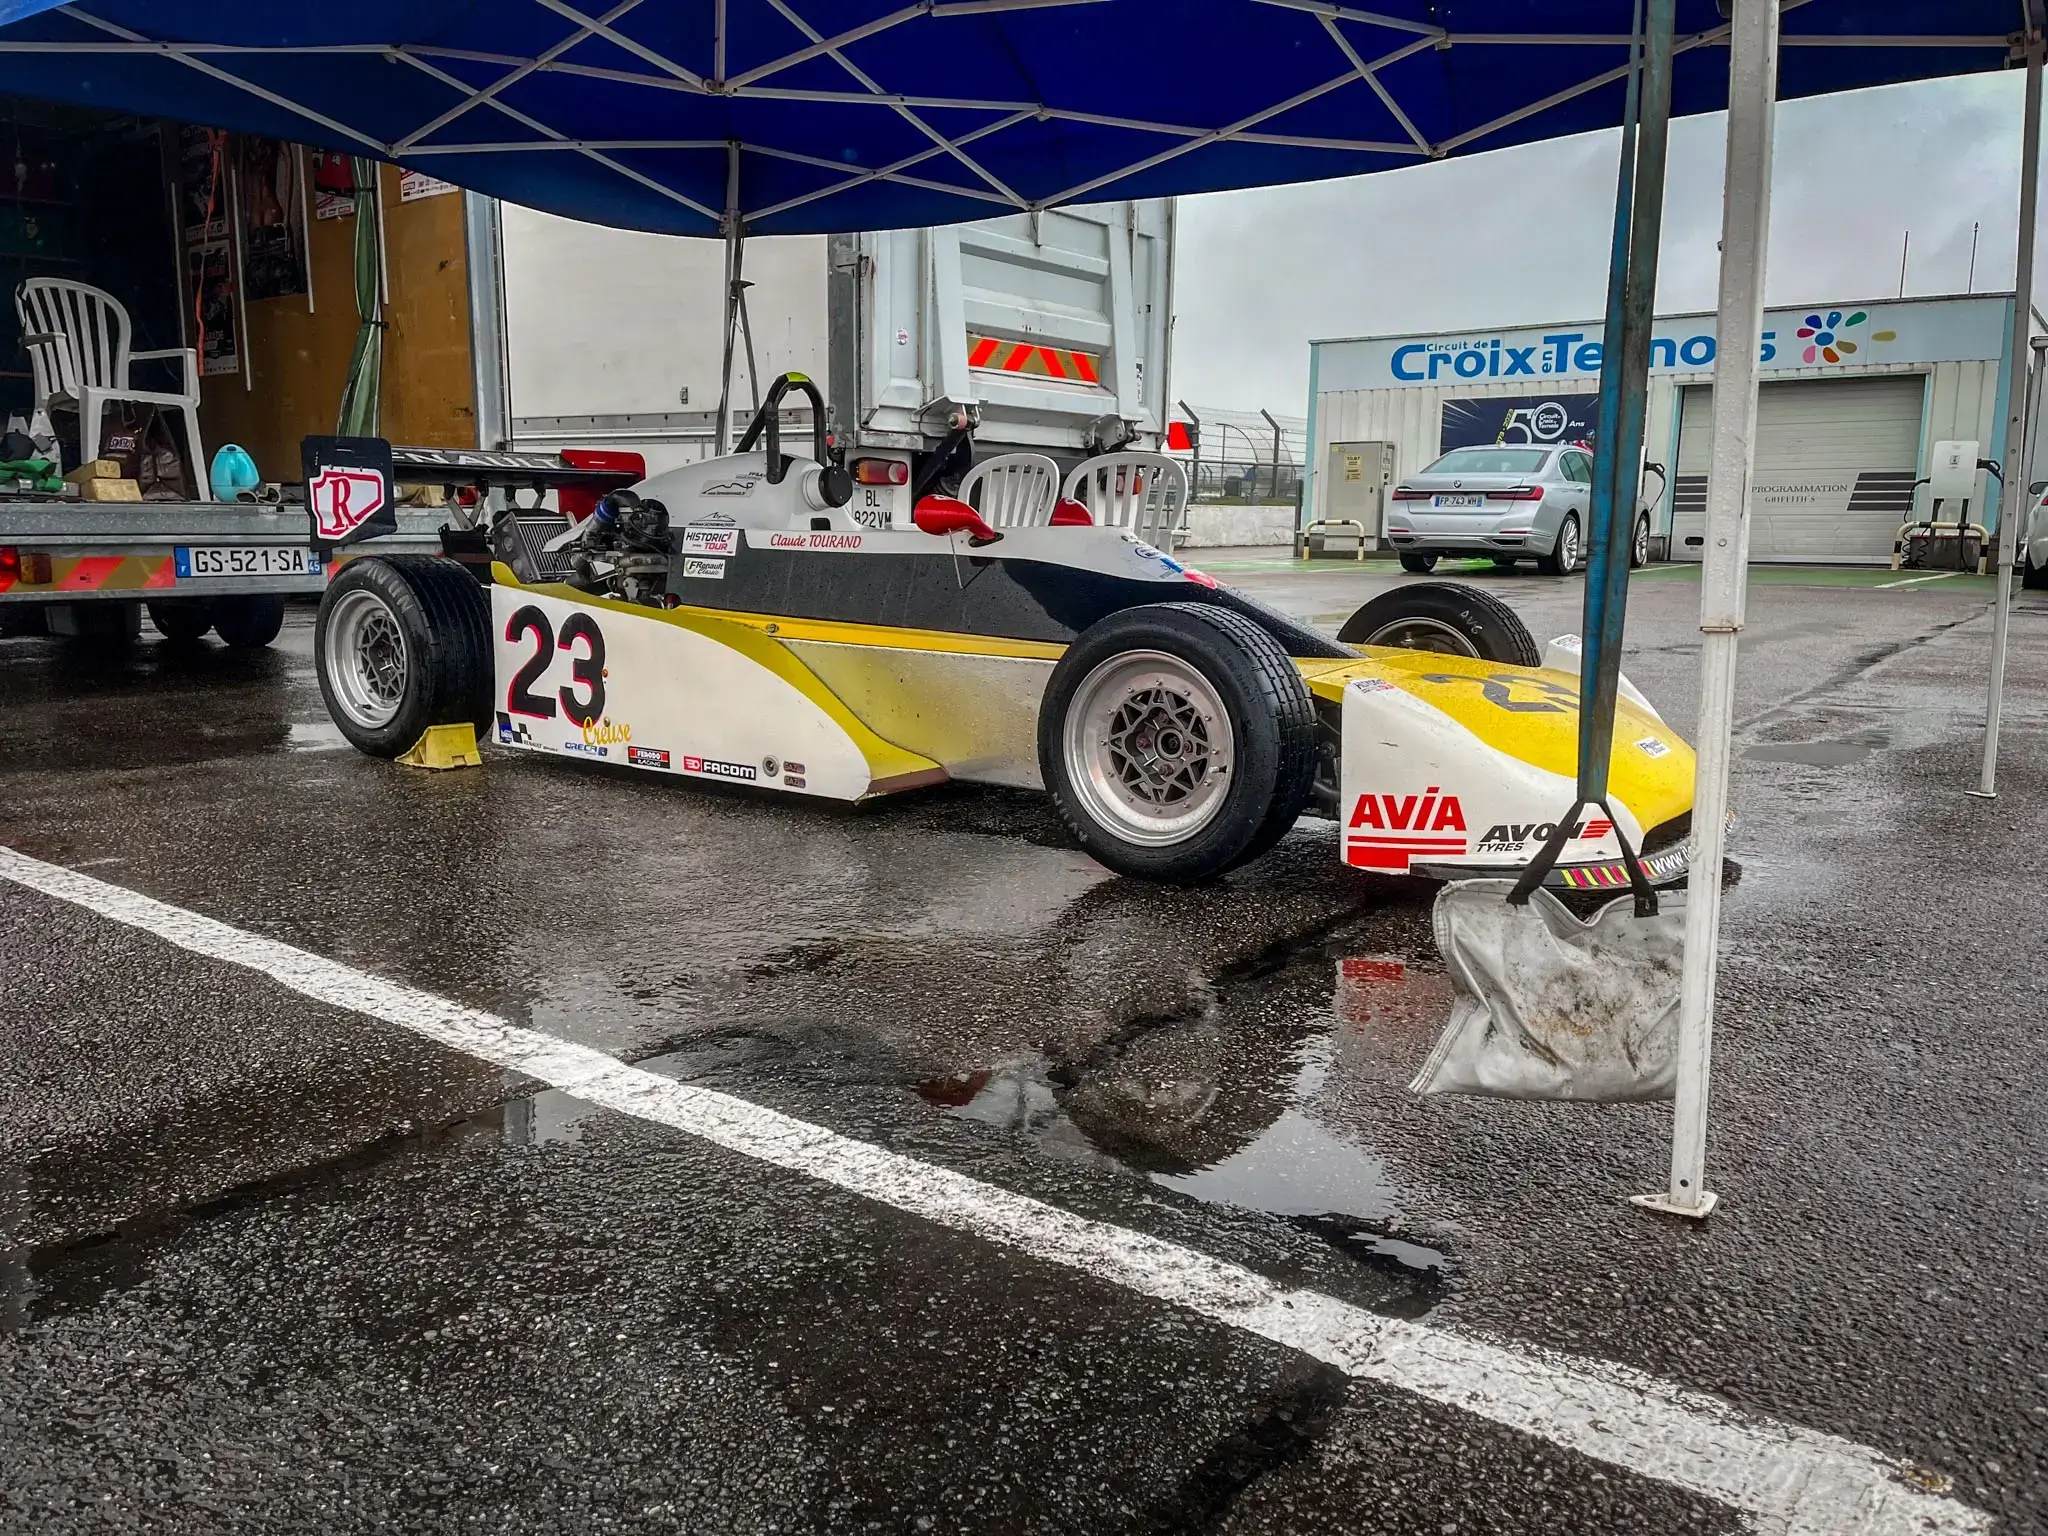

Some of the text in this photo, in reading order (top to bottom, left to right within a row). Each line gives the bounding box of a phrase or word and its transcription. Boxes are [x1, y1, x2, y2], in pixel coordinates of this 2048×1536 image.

[1427, 340, 1488, 351] Circuit de
[1391, 332, 1776, 380] Croix en Tenos
[1751, 484, 1848, 493] PROGRAMMATION
[329, 476, 358, 530] R
[866, 489, 880, 507] BL
[686, 532, 729, 543] HISTORIC
[770, 533, 862, 548] Claude TOURAND
[704, 542, 728, 550] TOUR
[195, 549, 304, 573] GS-521-SA
[309, 562, 320, 572] 45
[505, 604, 606, 729] 23
[583, 716, 632, 746] Creuse
[565, 742, 598, 753] ORECA
[636, 750, 662, 760] FERODO
[637, 758, 661, 767] RACING
[703, 761, 756, 779] FACOM
[1348, 786, 1467, 831] AVIA
[1477, 842, 1525, 853] TYRES
